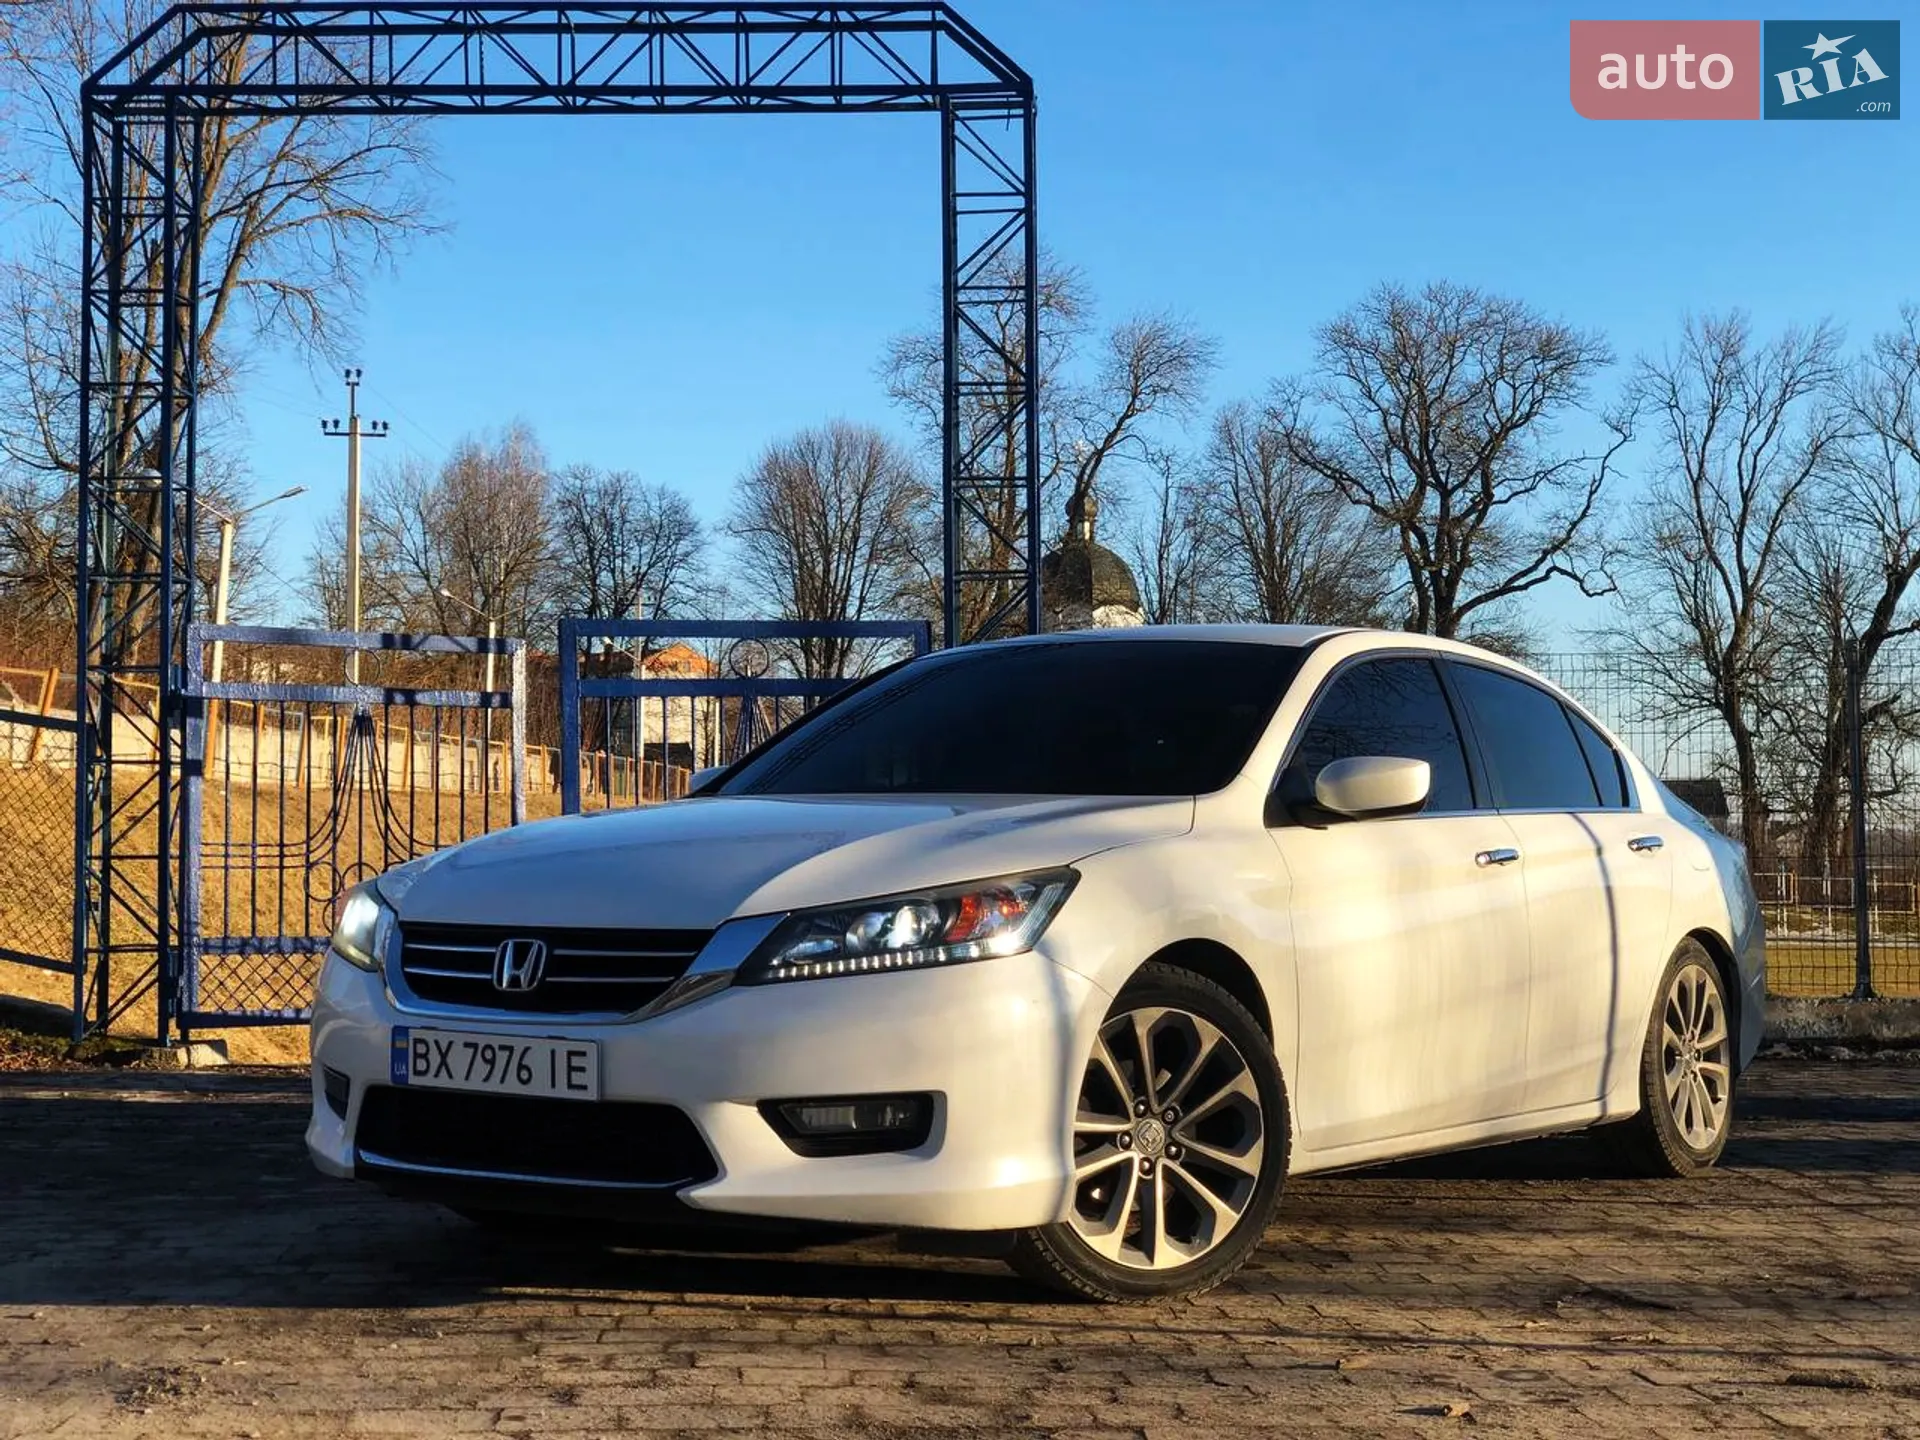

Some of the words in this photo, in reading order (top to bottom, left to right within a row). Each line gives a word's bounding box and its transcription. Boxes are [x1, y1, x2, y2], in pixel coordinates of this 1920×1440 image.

[394, 1063, 407, 1075] UA
[412, 1037, 454, 1079] BX
[463, 1042, 533, 1085] 7976
[550, 1048, 588, 1091] IE
